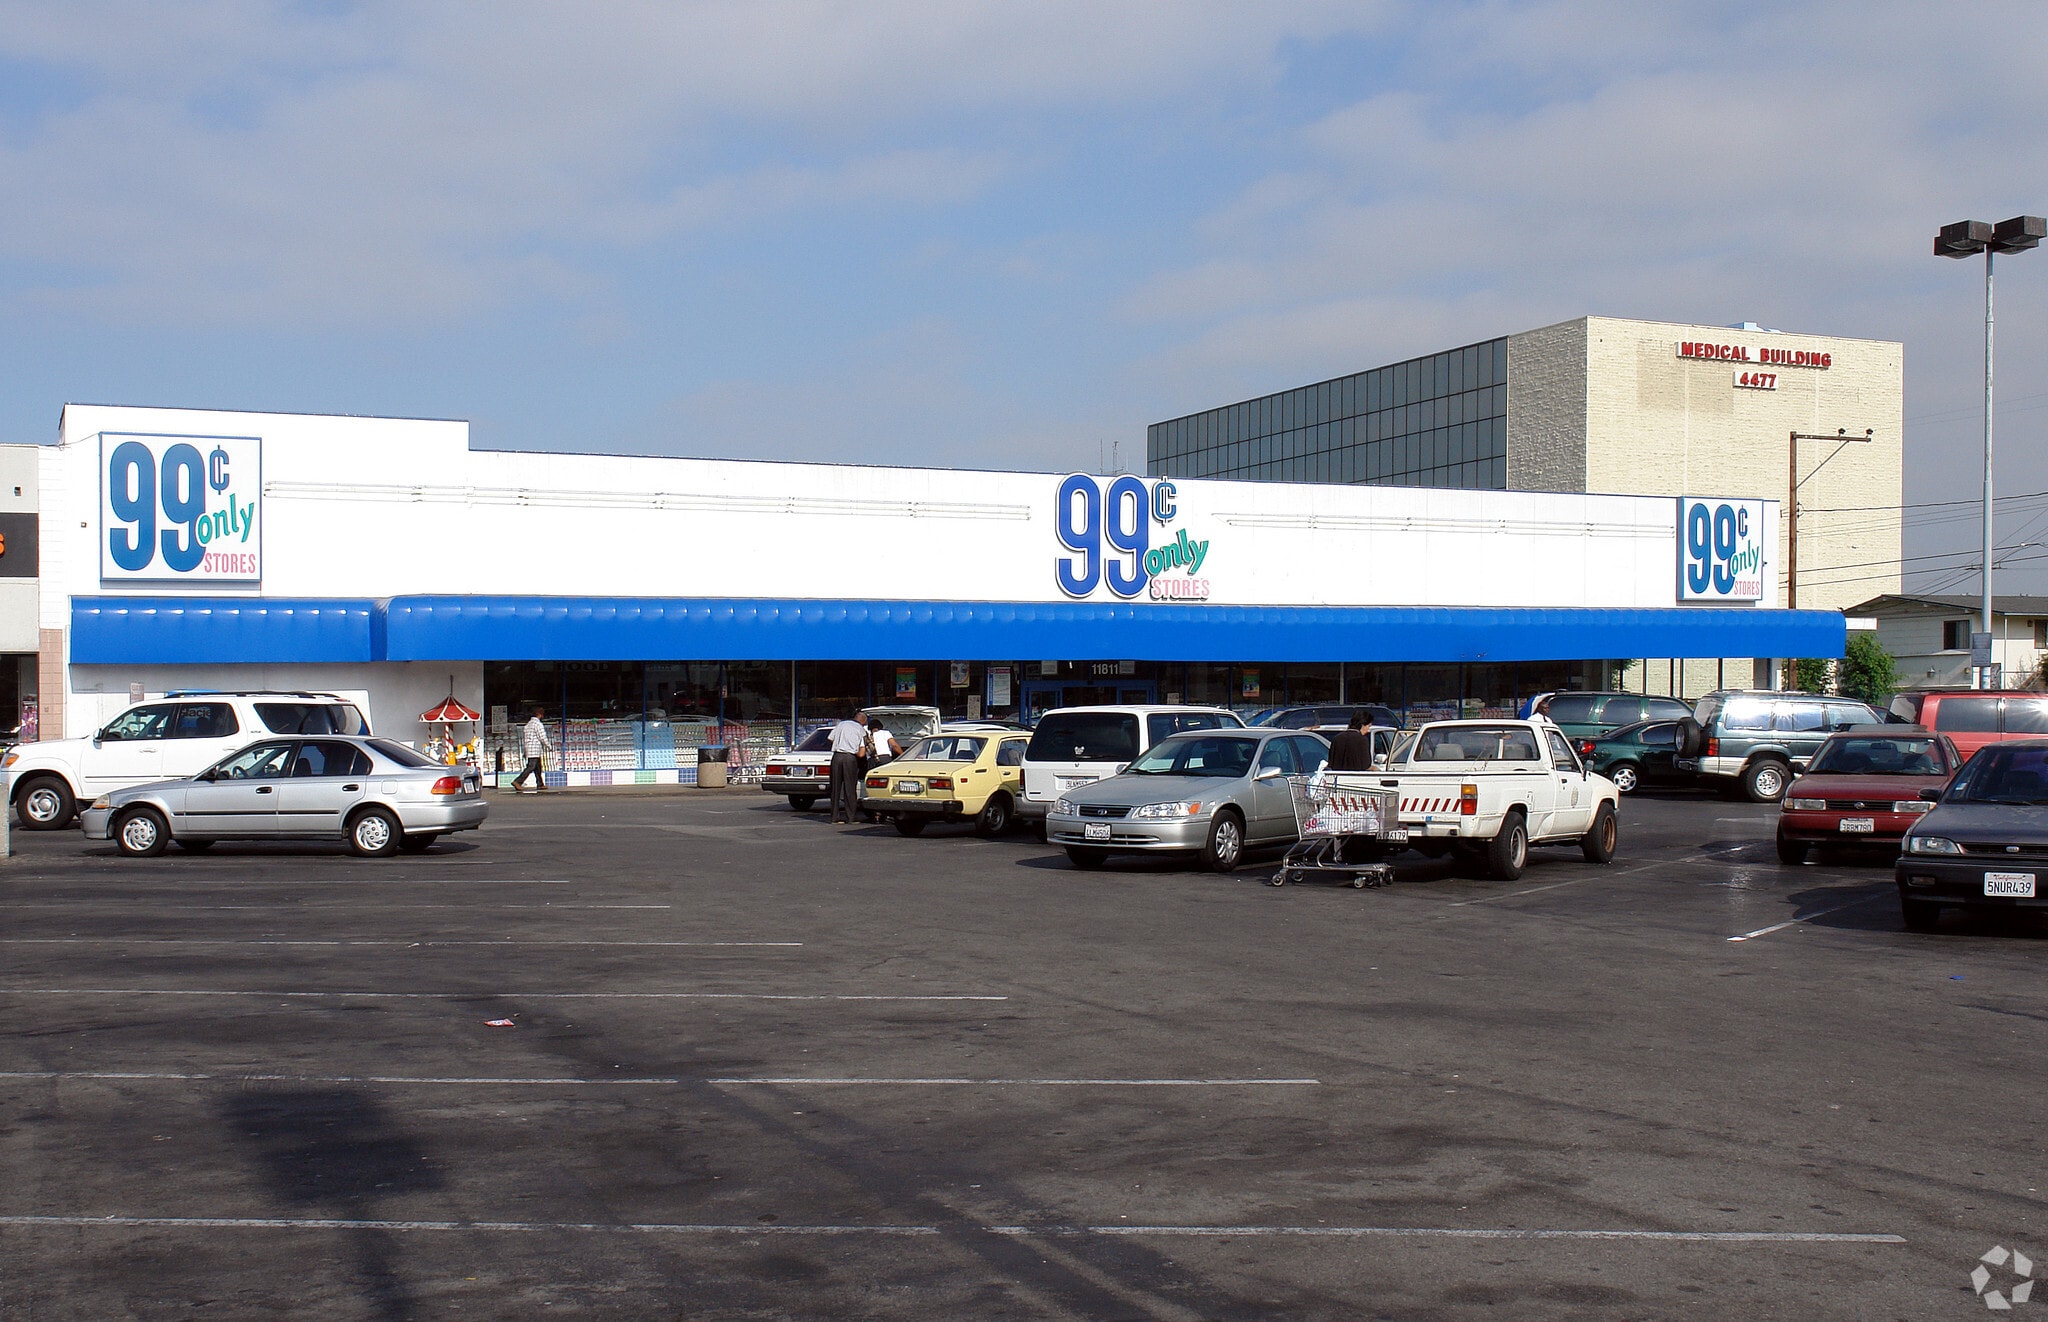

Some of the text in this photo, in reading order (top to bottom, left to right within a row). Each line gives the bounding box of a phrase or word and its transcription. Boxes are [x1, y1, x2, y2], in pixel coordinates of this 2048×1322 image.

[1681, 342, 1832, 368] MEDICAL BUILDING
[1739, 372, 1777, 388] 4477
[196, 493, 255, 544] only
[1145, 528, 1210, 576] only
[1729, 540, 1761, 577] only
[204, 553, 256, 574] STORES
[1152, 579, 1211, 597] STORES
[1733, 580, 1761, 597] STORES
[1092, 663, 1119, 675] 11811
[1987, 881, 2032, 894] 5NUR439
